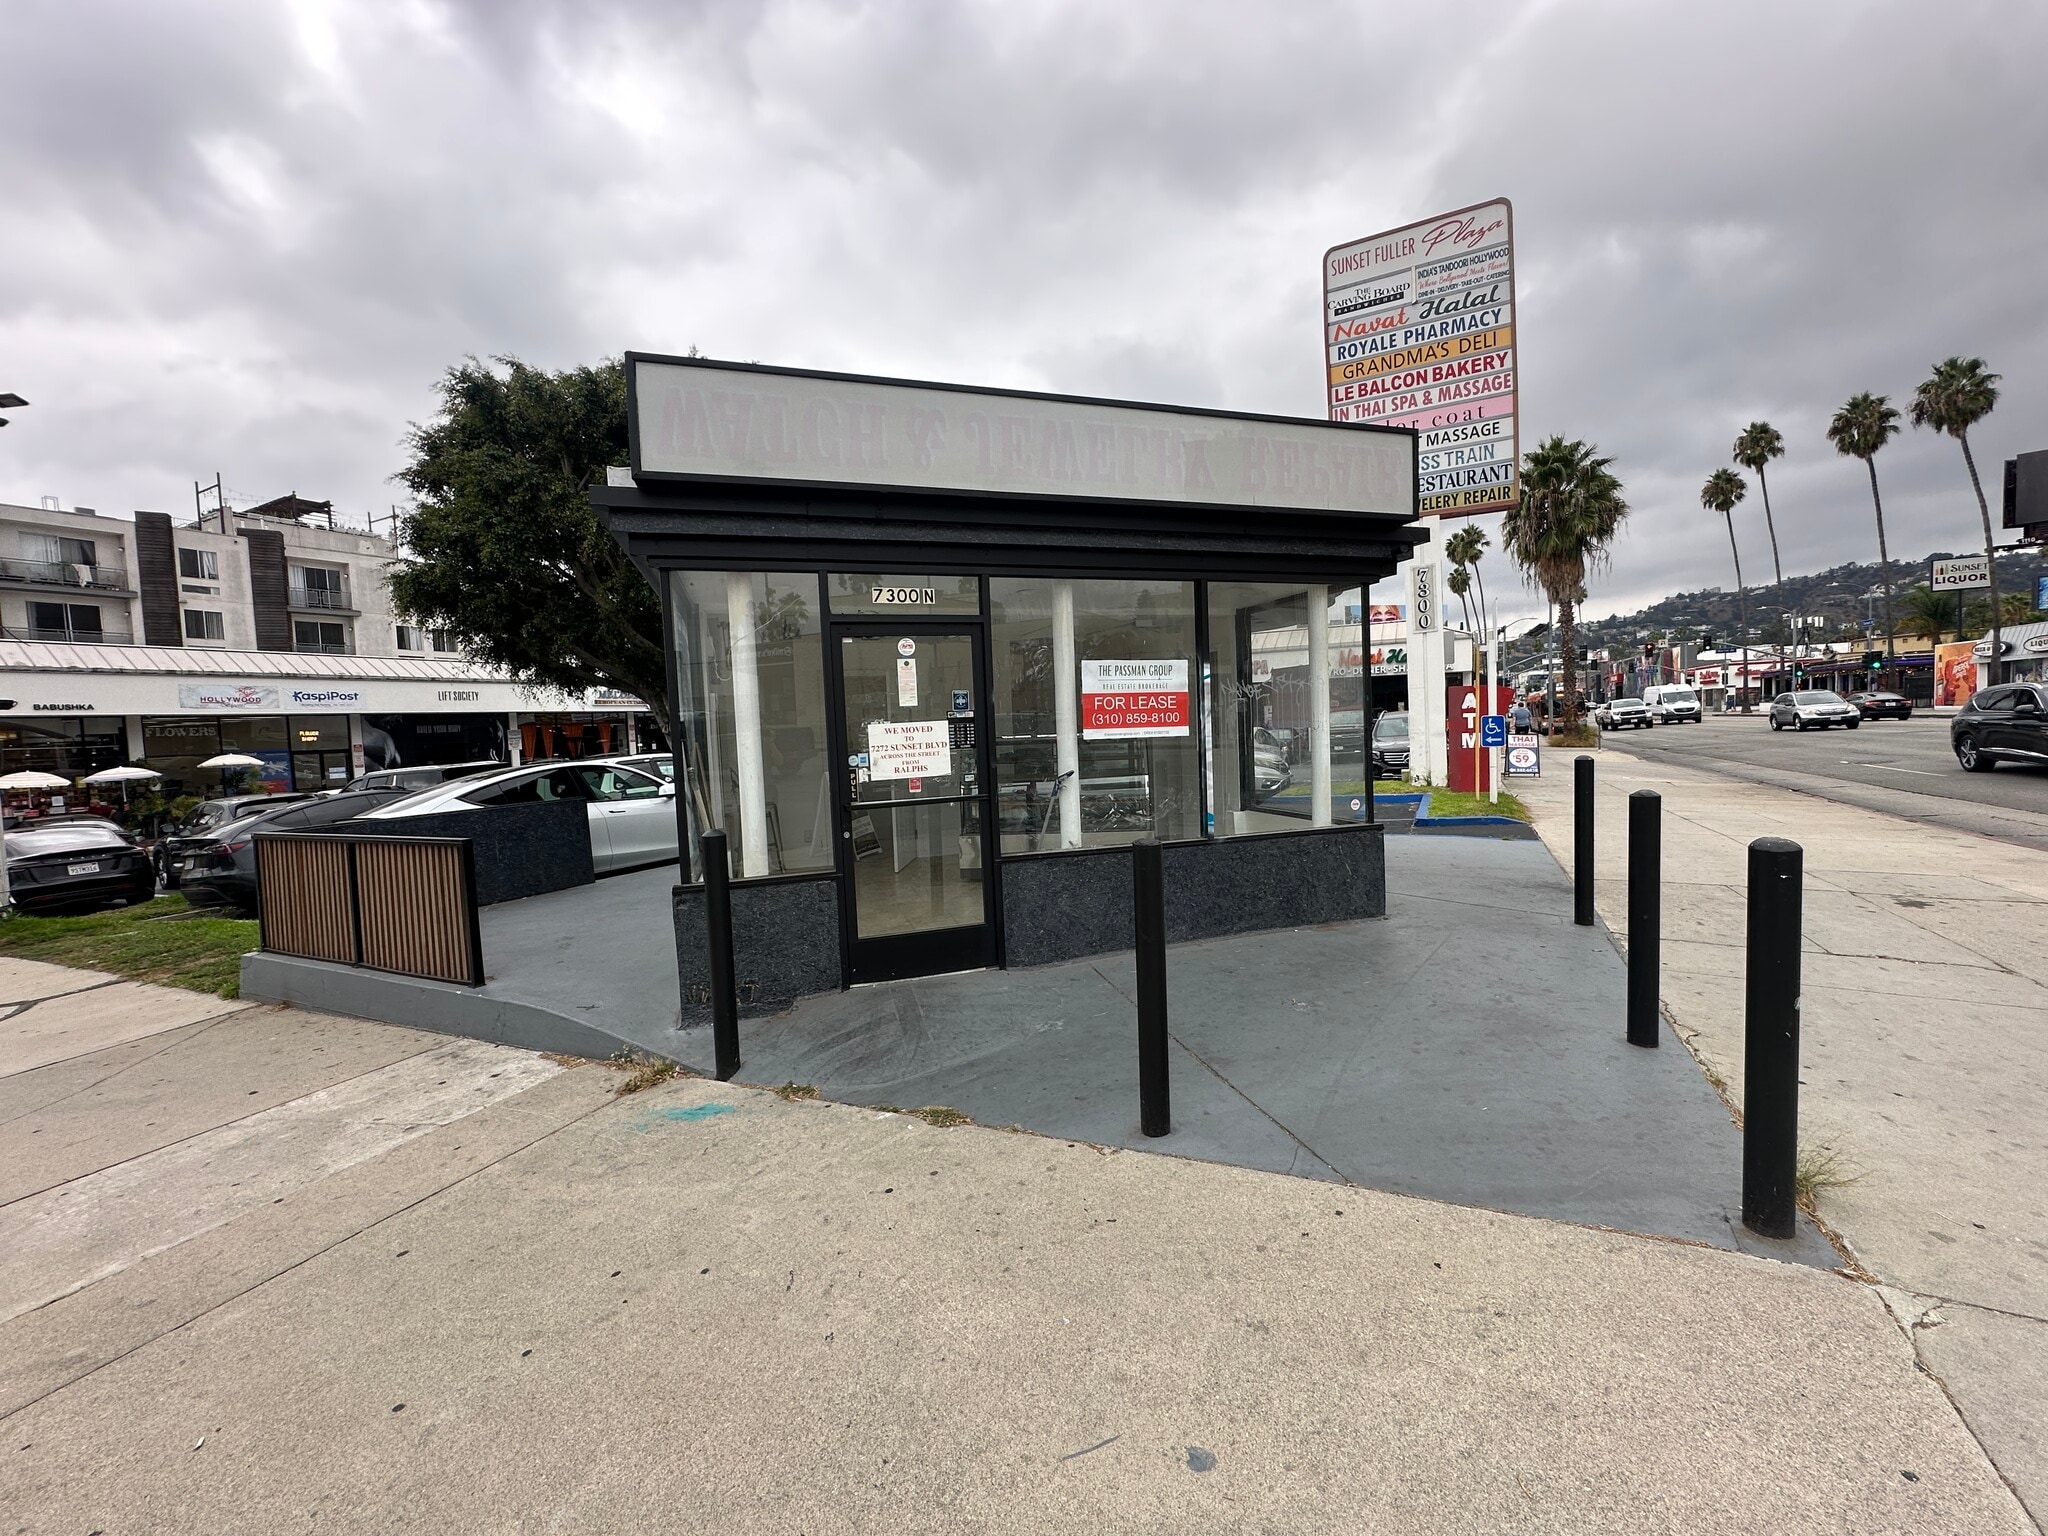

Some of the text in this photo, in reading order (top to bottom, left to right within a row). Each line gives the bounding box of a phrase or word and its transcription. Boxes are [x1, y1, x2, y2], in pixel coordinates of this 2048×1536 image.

[1332, 216, 1504, 276] SUNSET FULLER Plaza
[1418, 248, 1509, 280] INDIA'S TANDOORI HOLLYWOOD
[1328, 282, 1410, 309] CARVING BOARD
[1334, 284, 1501, 342] Navat Halal
[1338, 308, 1502, 360] ROYALE PHARMACY
[1343, 332, 1497, 380] GRANDMA'S DELI
[1335, 352, 1508, 402] LE BALCON BAKERY
[1354, 400, 1386, 418] THAI
[1392, 393, 1418, 412] SPA
[1422, 390, 1433, 405] &
[1438, 372, 1511, 402] MASSAGE
[1432, 406, 1485, 427] coat
[1427, 422, 1500, 446] MASSAGE
[1444, 444, 1494, 466] TRAIN
[1419, 464, 1512, 493] ESTAURANT
[1419, 486, 1511, 510] ELERY REPAIR
[1935, 573, 1987, 584] LIQUOR
[1950, 563, 1987, 572] SUNSET
[1417, 568, 1430, 629] 7300
[1098, 665, 1172, 676] THE PASSMAN GROUP
[293, 690, 359, 702] KaspiPost
[438, 691, 479, 701] LIFT SOCIETY
[1094, 696, 1177, 710] FOR LEASE
[901, 726, 933, 734] MOVED
[1092, 712, 1180, 726] (310) 859-8100
[1462, 693, 1480, 748] ATM
[145, 727, 216, 737] FLOWERS
[890, 743, 923, 751] SUNSET
[894, 765, 928, 774] RALPHS
